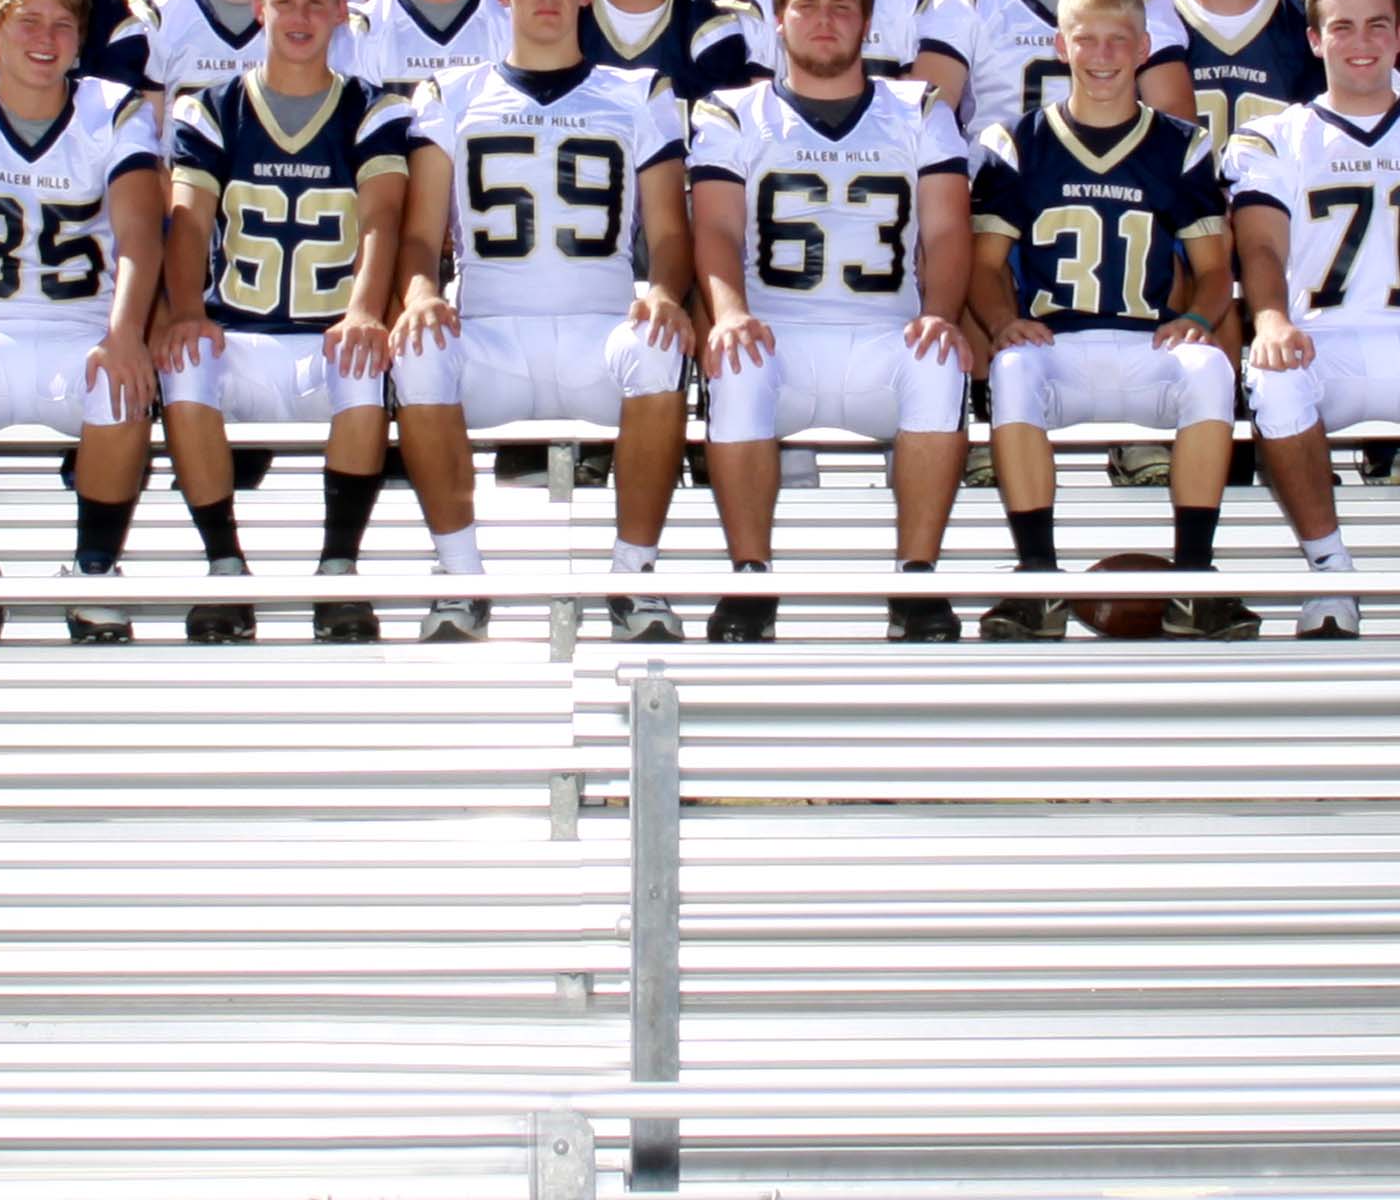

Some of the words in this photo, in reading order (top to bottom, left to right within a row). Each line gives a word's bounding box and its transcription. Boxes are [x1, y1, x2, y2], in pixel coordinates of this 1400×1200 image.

[196, 59, 236, 70] SALEM
[1194, 67, 1267, 84] SKYHAWKS
[502, 114, 544, 126] SALEM
[550, 116, 586, 128] HILLS
[796, 150, 839, 162] SALEM
[846, 150, 880, 162] HILLS
[253, 162, 331, 179] SKYHAWKS
[1331, 159, 1372, 172] SALEM
[37, 175, 70, 190] HILLS
[465, 135, 626, 261] 59
[1062, 183, 1143, 202] SKYHAWKS
[756, 169, 912, 294] 63
[220, 180, 360, 318] 62
[1030, 205, 1161, 320] 31
